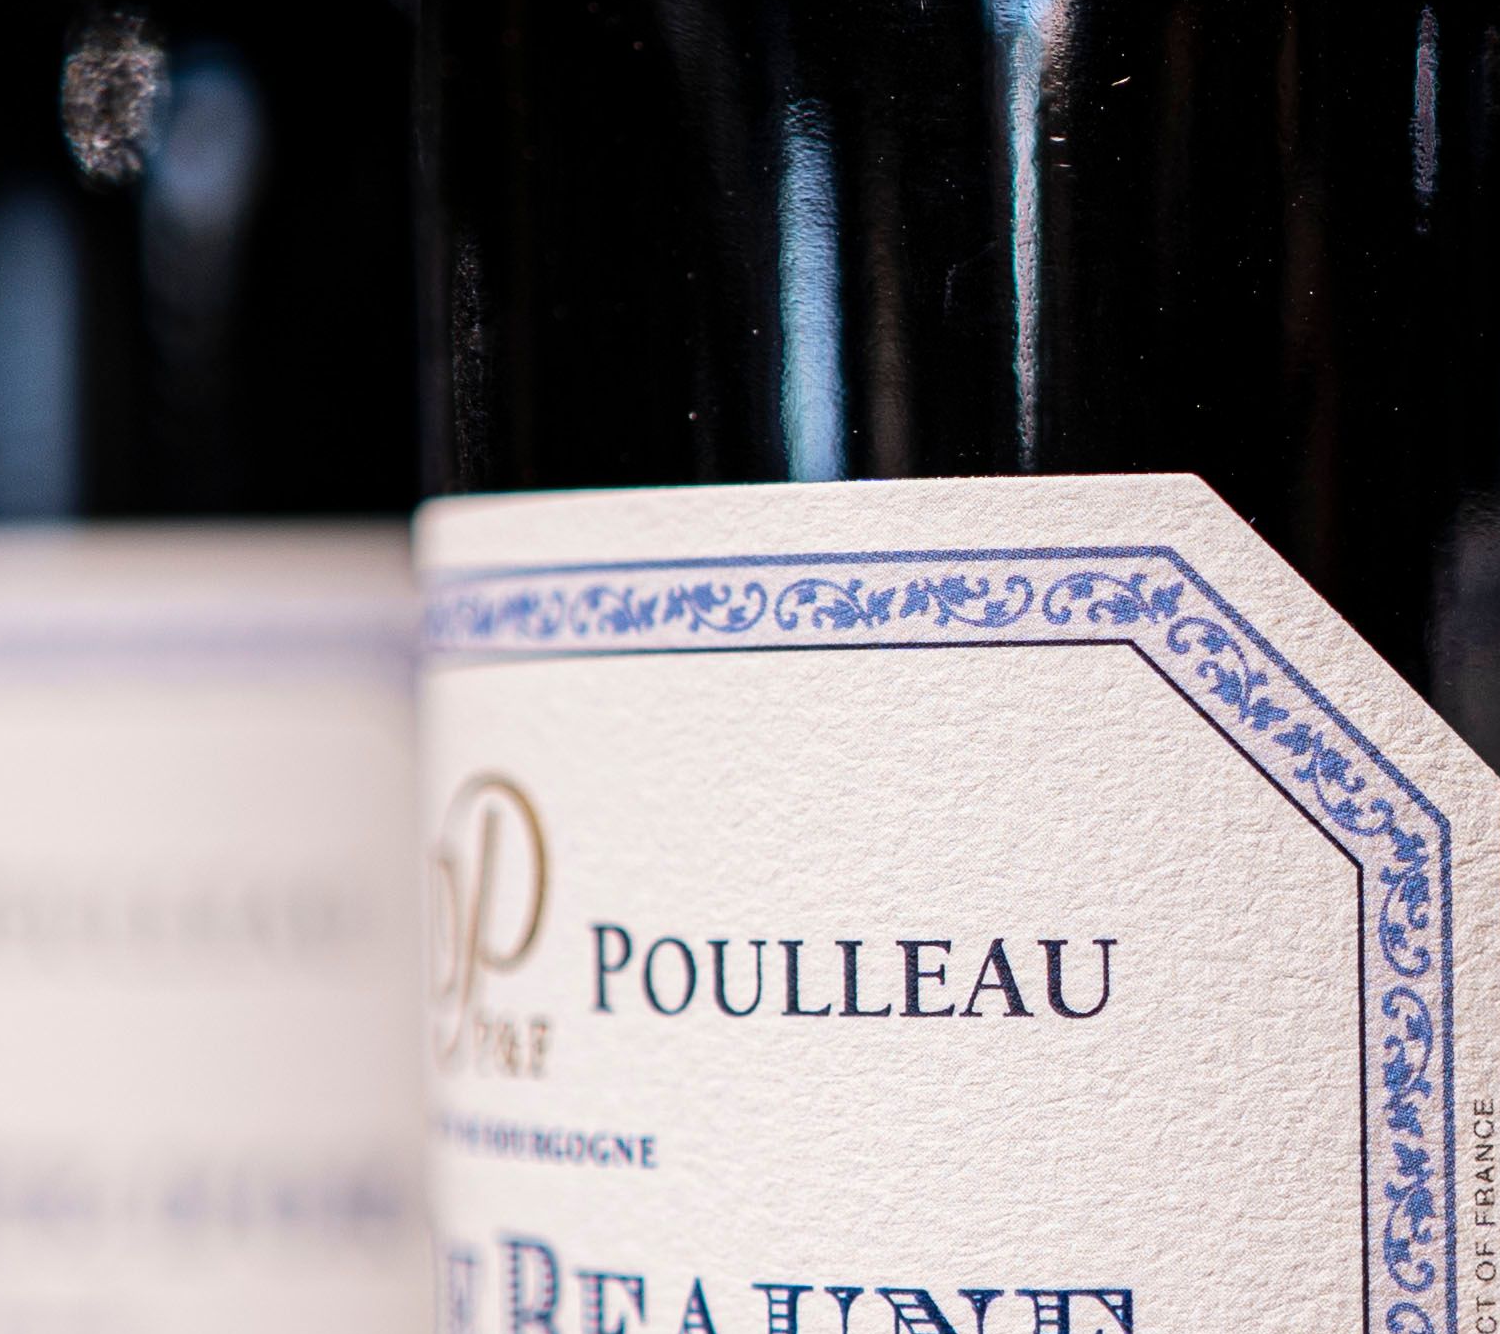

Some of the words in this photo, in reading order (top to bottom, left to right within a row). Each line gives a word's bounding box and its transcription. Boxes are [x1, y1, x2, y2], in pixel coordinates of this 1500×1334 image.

[590, 923, 1119, 1020] POULLEAU
[1473, 1097, 1496, 1227] FRANCE
[1474, 1241, 1498, 1283] OF
